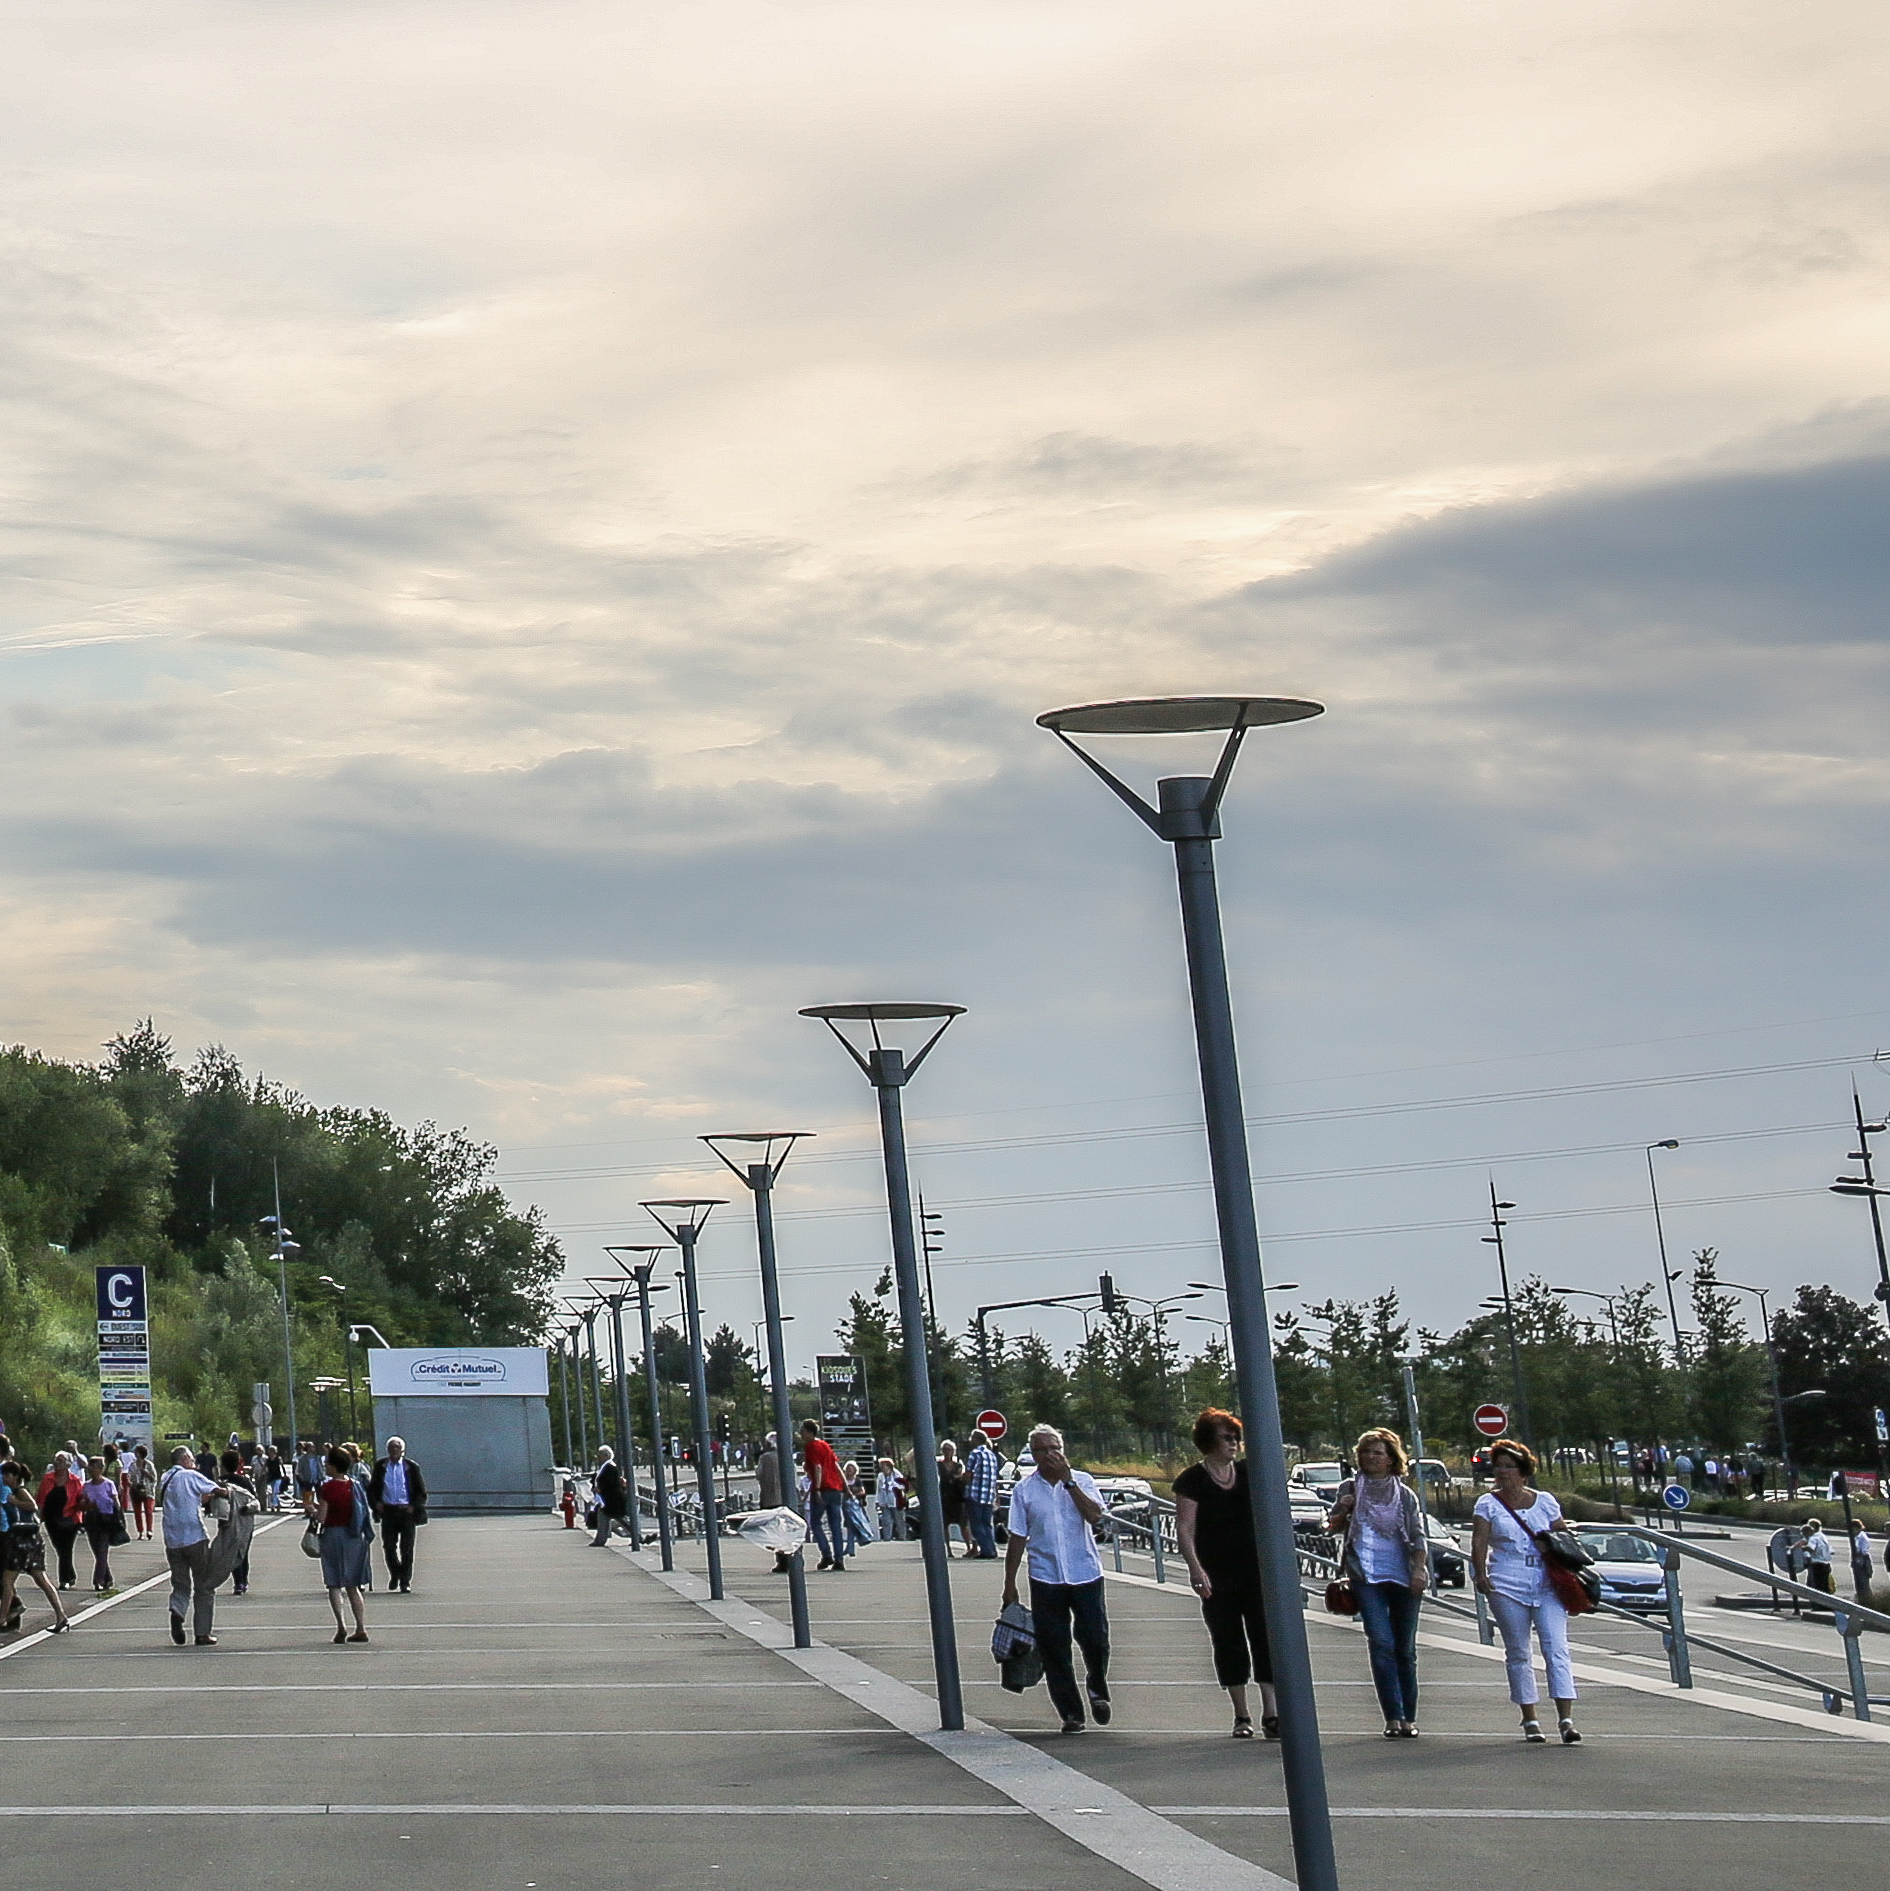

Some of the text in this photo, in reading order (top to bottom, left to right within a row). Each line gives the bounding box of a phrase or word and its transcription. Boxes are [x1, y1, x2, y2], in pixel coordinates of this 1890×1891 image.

[108, 1274, 133, 1308] C
[112, 1310, 131, 1318] NORD
[419, 1364, 497, 1374] Crédit Mutuel
[830, 1374, 854, 1383] STADE
